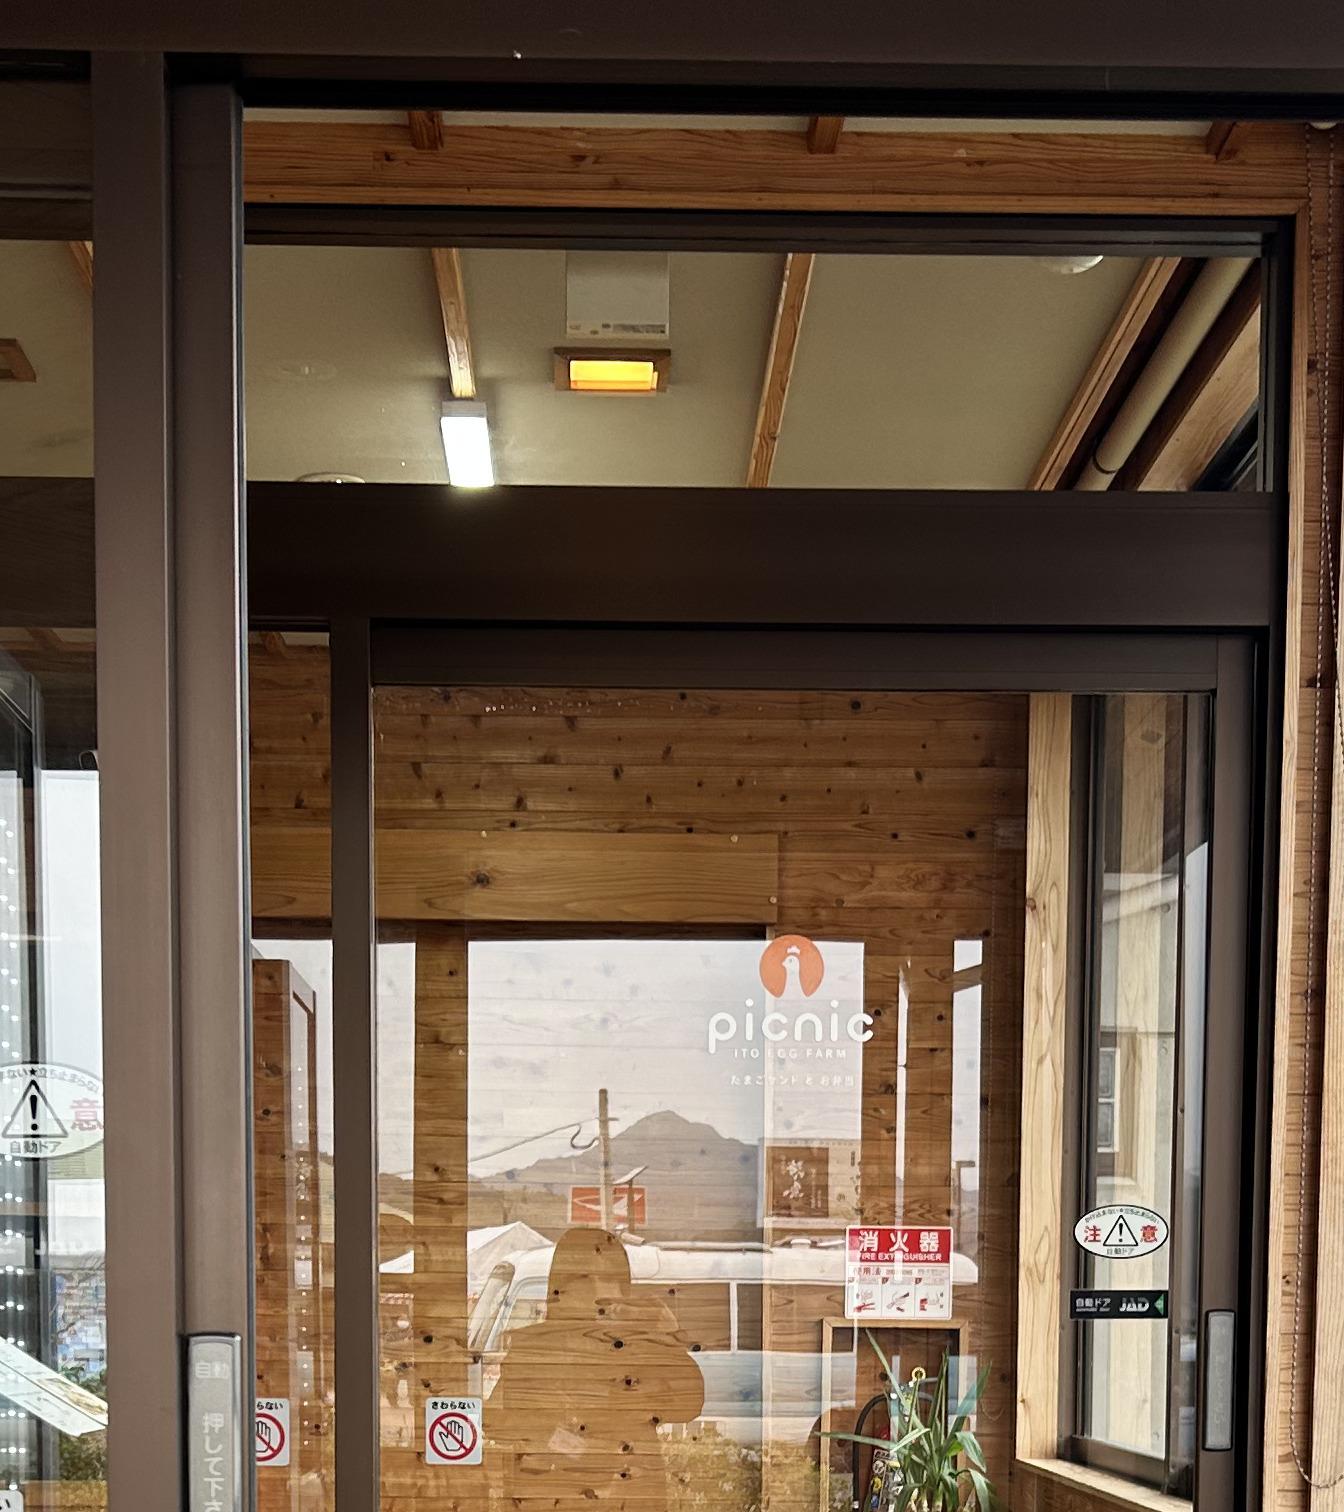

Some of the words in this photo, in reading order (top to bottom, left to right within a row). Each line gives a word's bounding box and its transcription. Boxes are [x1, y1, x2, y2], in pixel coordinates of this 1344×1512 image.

[708, 998, 874, 1054] picnic
[734, 1048, 760, 1059] ITO
[806, 1048, 847, 1059] FARM
[9, 1140, 62, 1154] 自動ドア
[859, 1230, 940, 1252] 消火器
[1083, 1225, 1102, 1243] 注
[194, 1361, 230, 1380] 自動
[431, 1400, 477, 1411] さわらない
